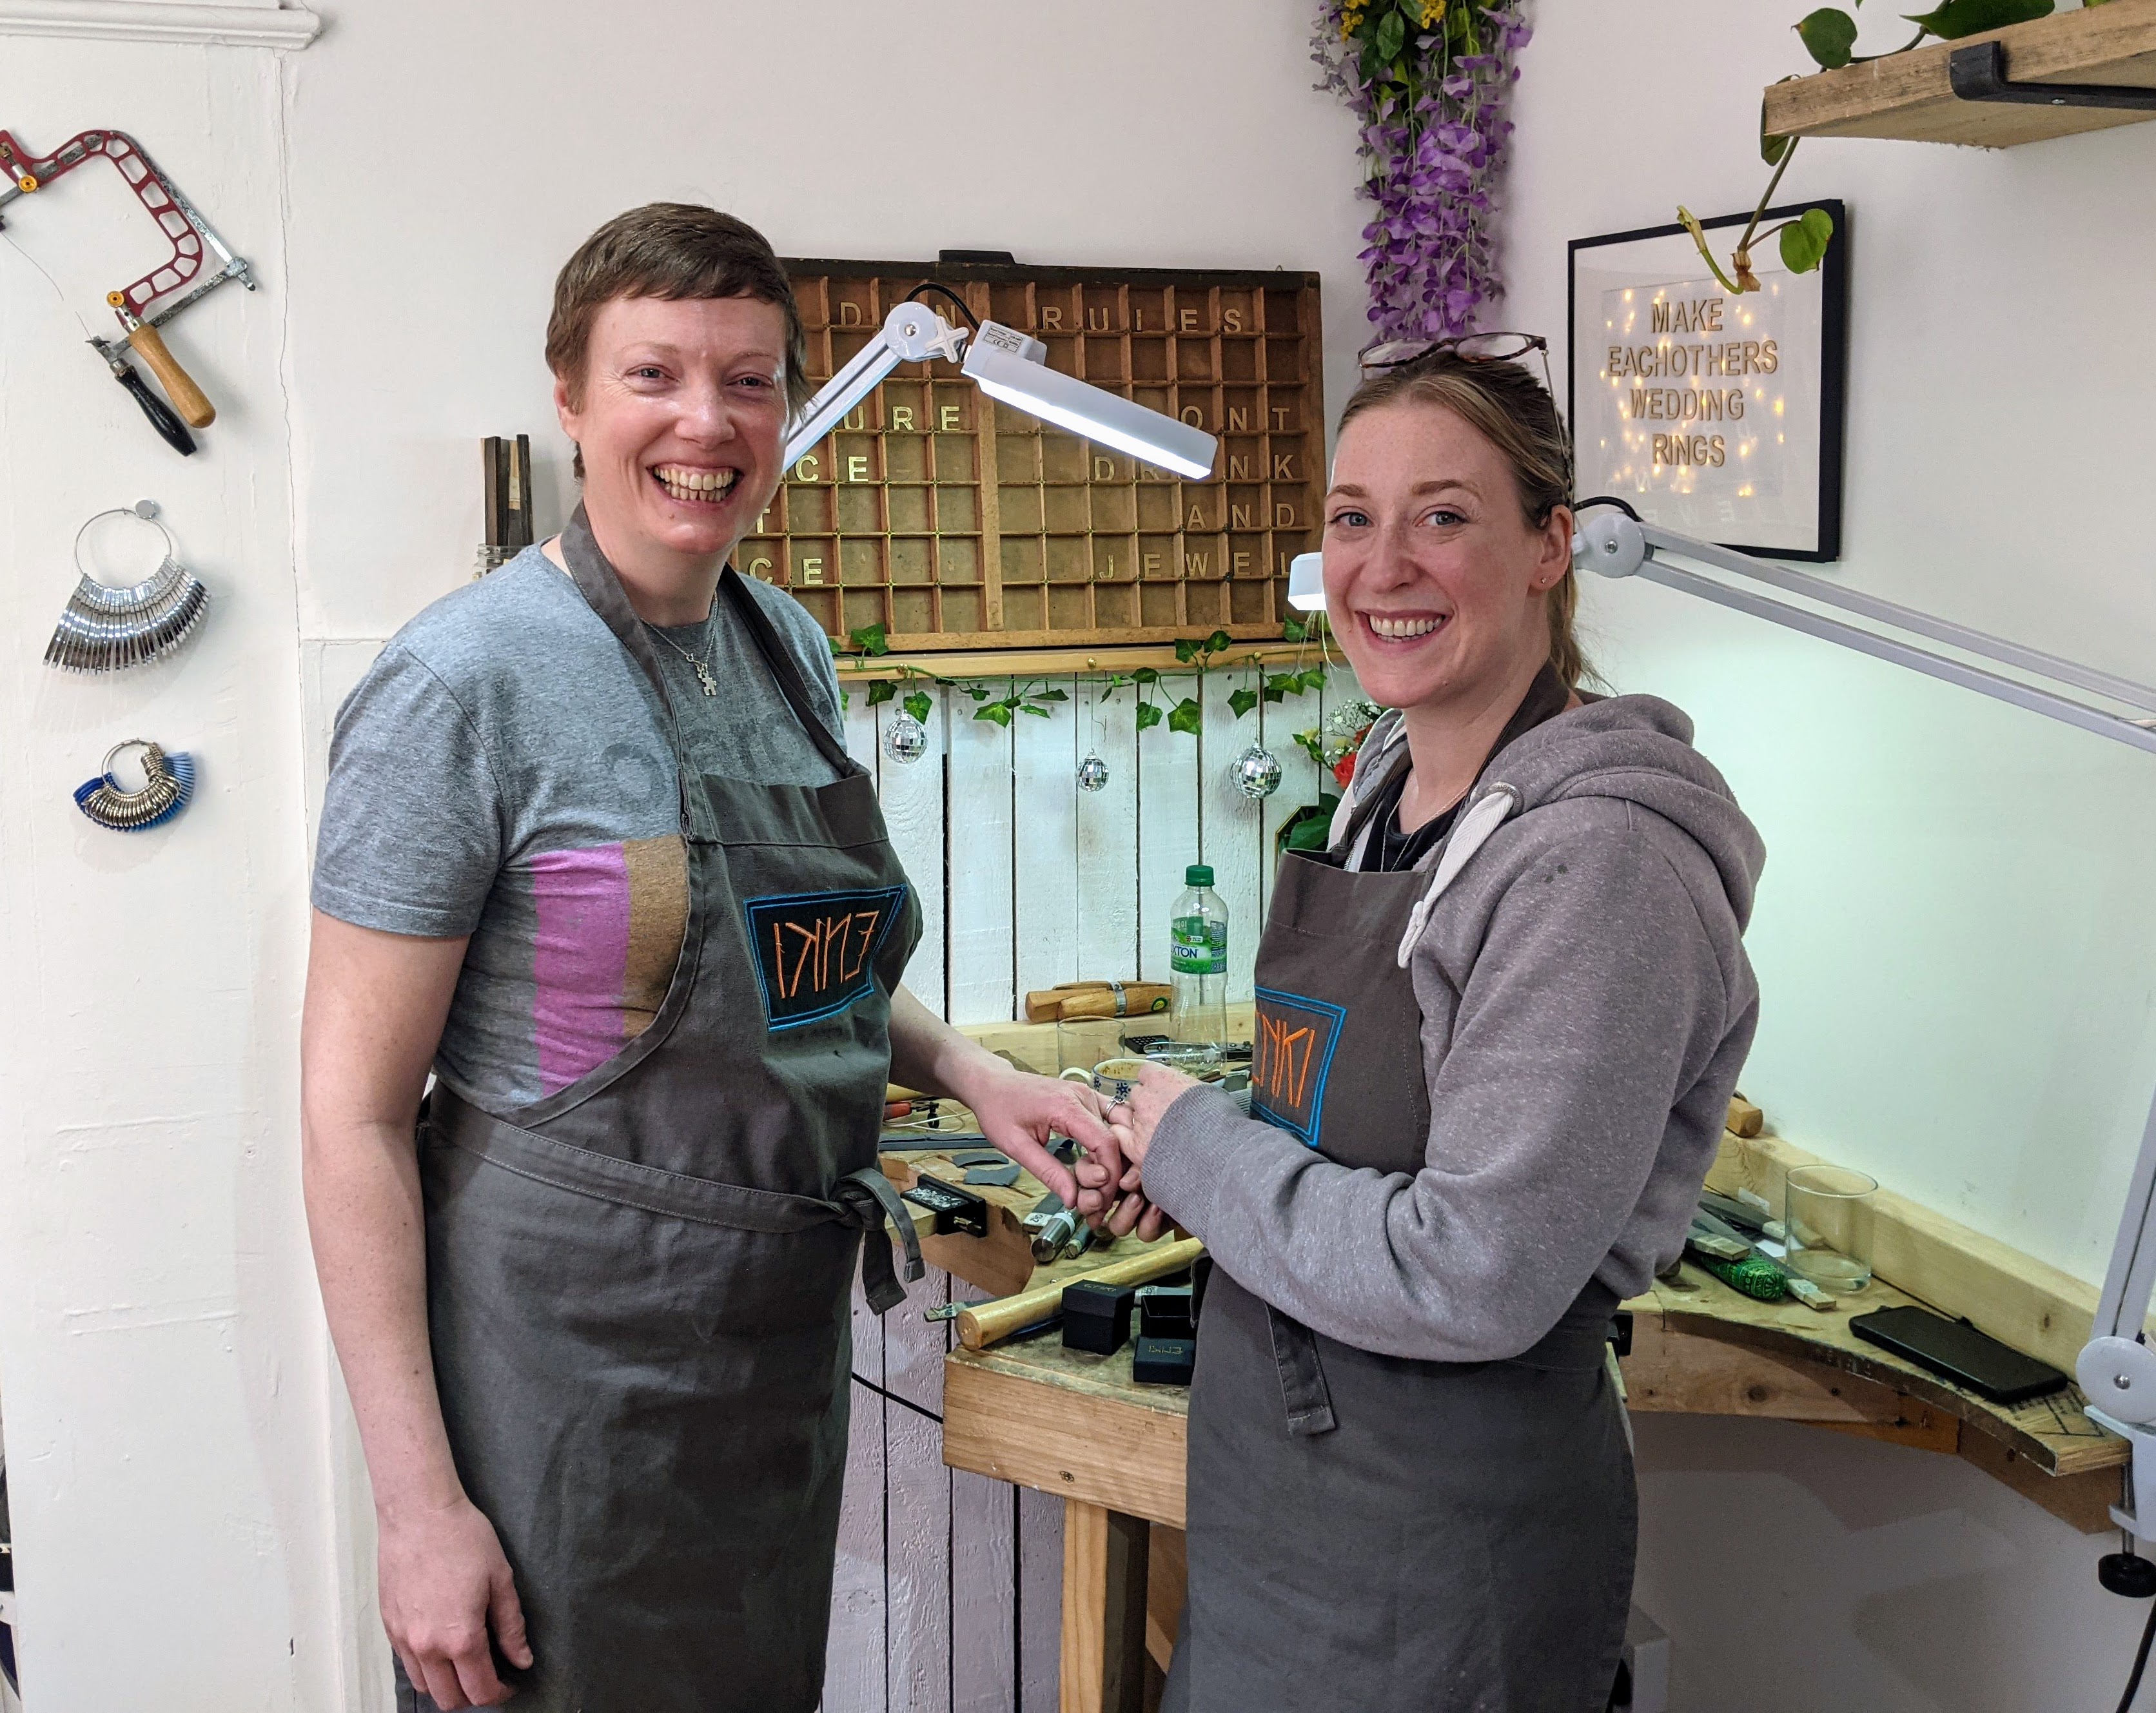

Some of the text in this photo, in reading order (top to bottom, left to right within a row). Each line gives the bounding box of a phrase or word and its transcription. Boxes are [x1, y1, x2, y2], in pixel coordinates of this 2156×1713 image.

[840, 302, 956, 328] DN
[1651, 299, 1723, 334] MAKE
[1608, 340, 1778, 378] EACHOTHERS
[1630, 388, 1744, 421] WEDDING
[1652, 434, 1725, 467] RINGS
[1094, 455, 1294, 481] DRNK
[1187, 503, 1295, 528] AND
